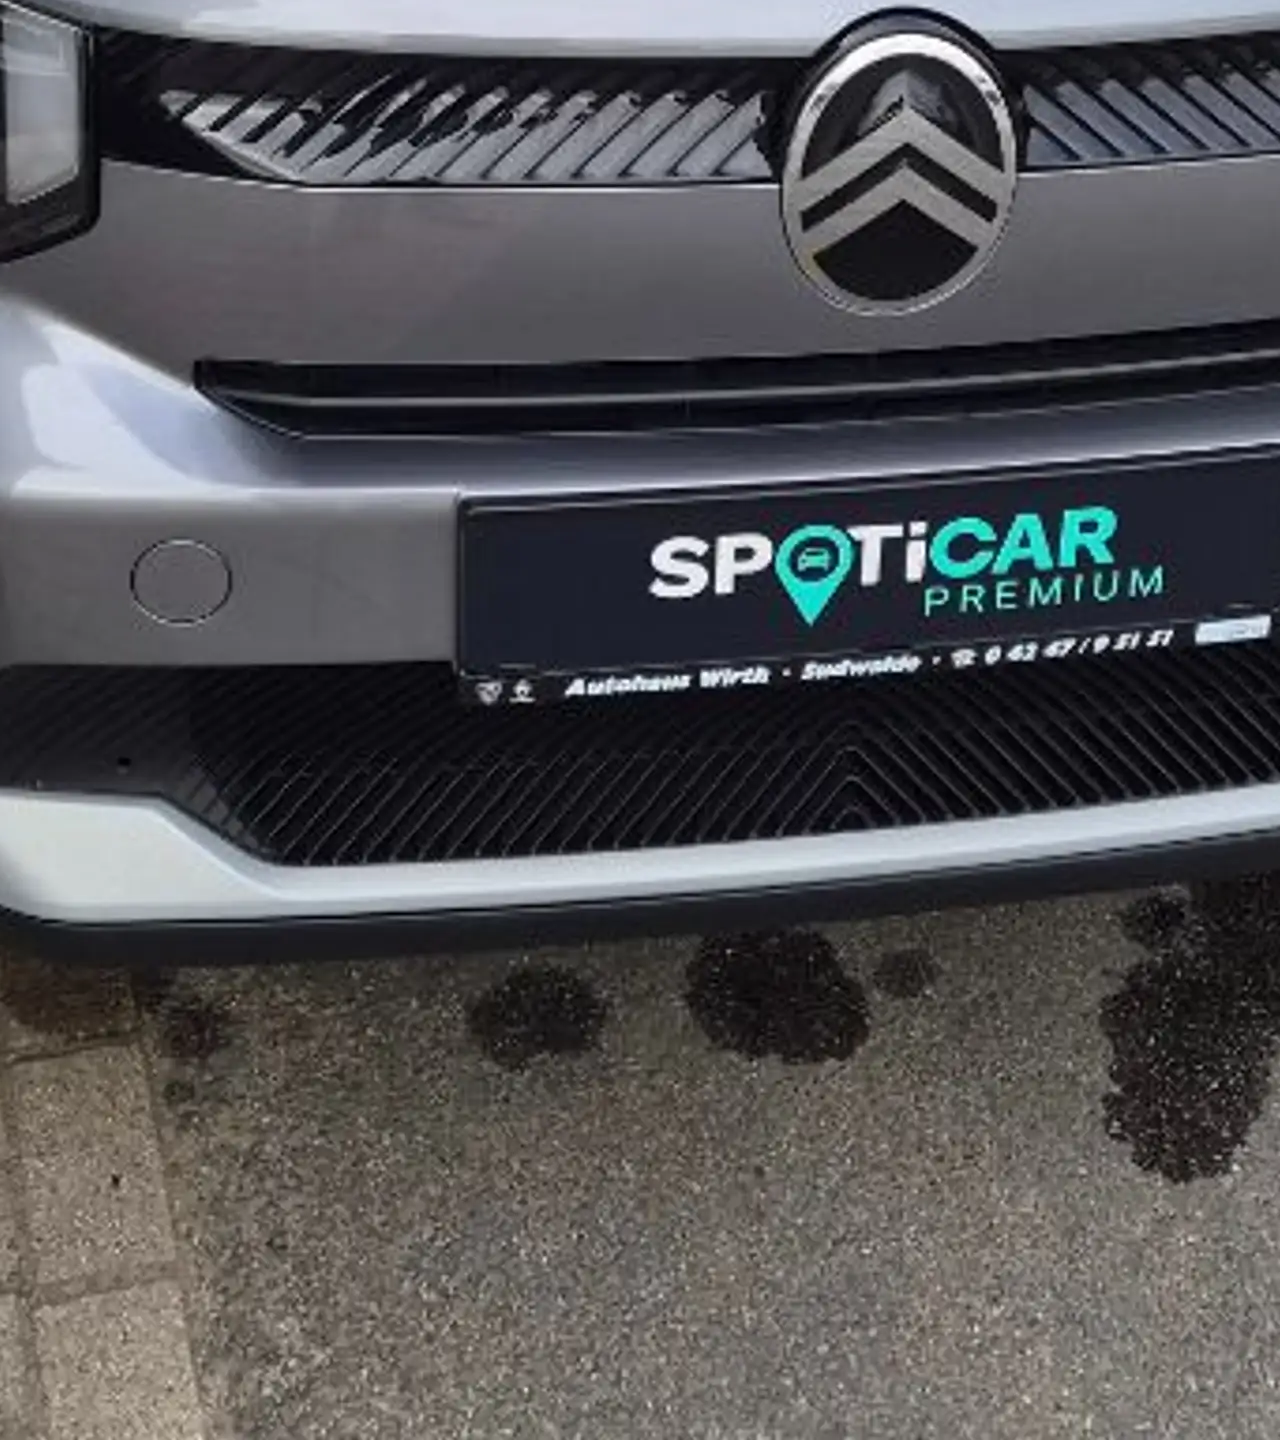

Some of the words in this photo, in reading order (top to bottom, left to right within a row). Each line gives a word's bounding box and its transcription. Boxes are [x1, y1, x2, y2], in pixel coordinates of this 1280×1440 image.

[923, 564, 1166, 618] PREMIUM
[565, 674, 691, 696] Autohaus
[699, 667, 771, 688] Wirth
